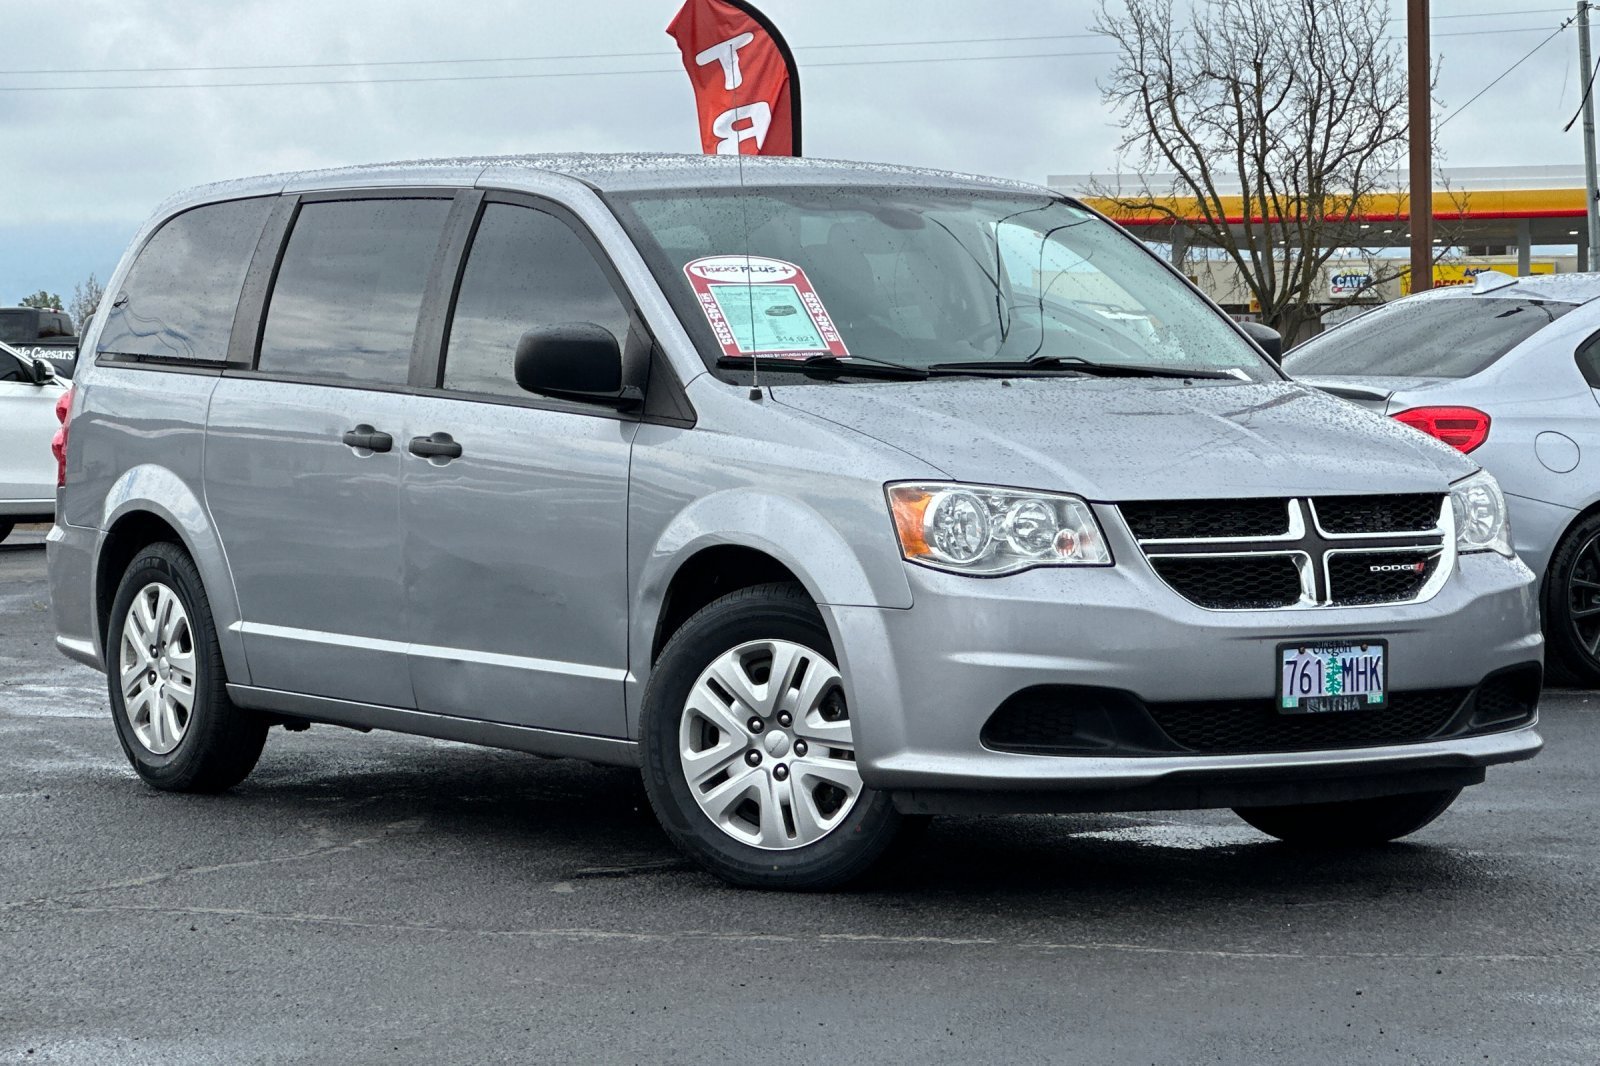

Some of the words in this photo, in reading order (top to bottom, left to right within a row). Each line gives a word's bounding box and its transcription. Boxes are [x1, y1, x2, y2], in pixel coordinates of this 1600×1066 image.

[31, 346, 75, 360] Caesars
[1369, 564, 1417, 572] DODGE
[1285, 659, 1322, 696] 761
[1341, 656, 1381, 693] MHK
